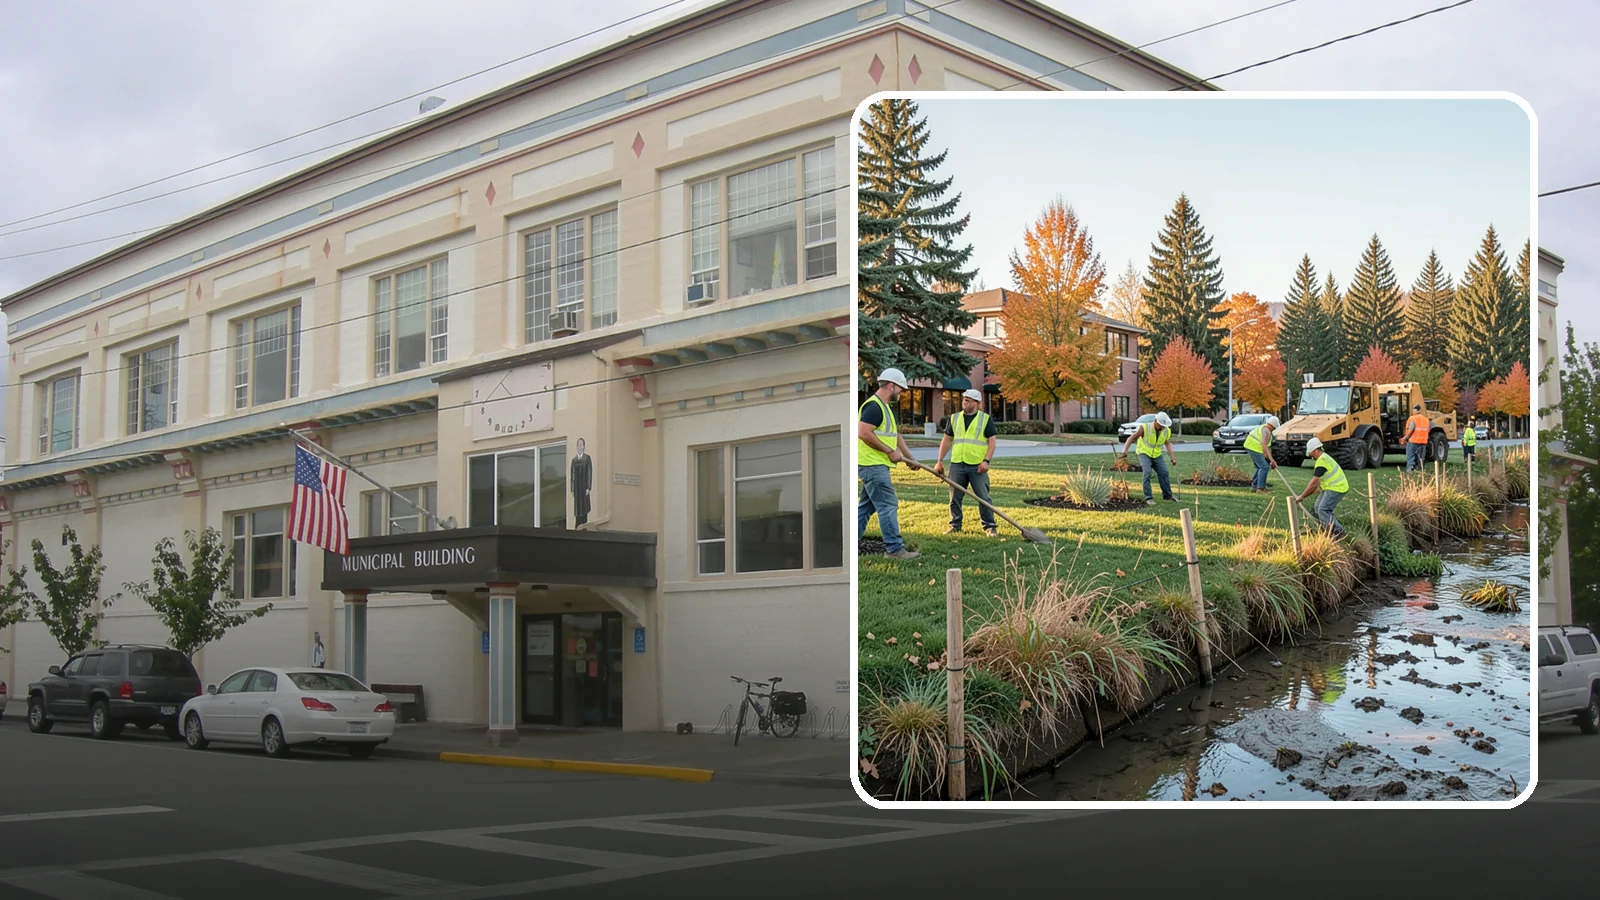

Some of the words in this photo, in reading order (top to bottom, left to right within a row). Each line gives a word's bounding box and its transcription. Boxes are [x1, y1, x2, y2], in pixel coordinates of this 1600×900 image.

[546, 361, 551, 370] 6
[475, 390, 479, 398] 7
[536, 402, 540, 410] 4
[481, 407, 485, 415] 8
[529, 414, 533, 422] 3
[488, 417, 492, 425] 9
[507, 425, 513, 433] 12
[521, 420, 525, 428] 2
[342, 552, 405, 571] MUNICIPAL
[414, 546, 475, 567] BUILDING
